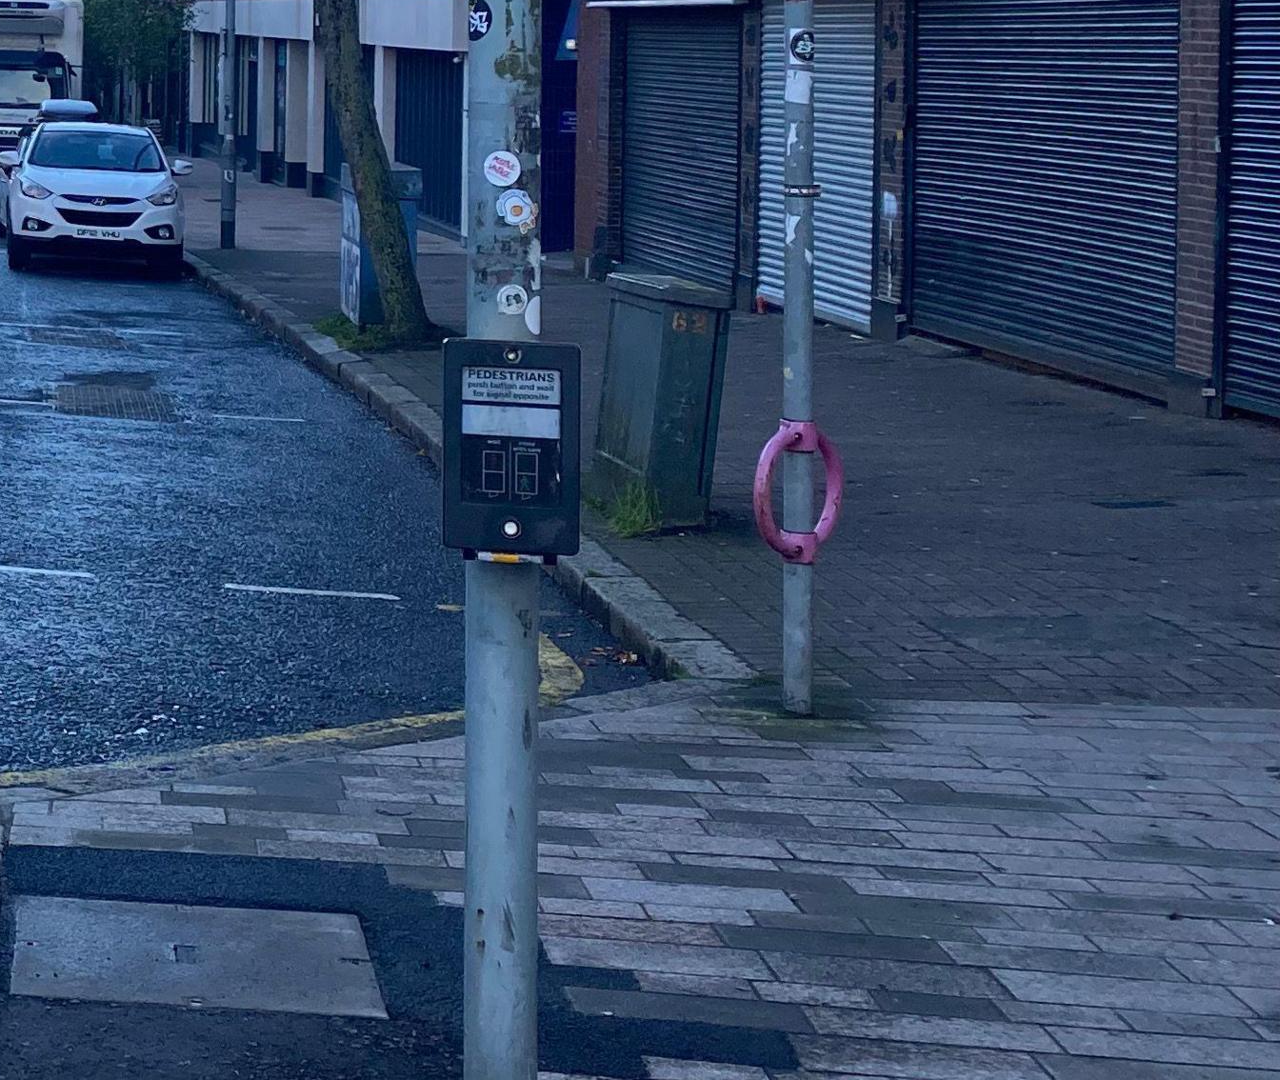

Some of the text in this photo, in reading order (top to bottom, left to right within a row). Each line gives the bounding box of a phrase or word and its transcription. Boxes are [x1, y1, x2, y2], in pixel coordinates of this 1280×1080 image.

[467, 368, 556, 383] PEDESTRIANS
[467, 381, 555, 392] push button and wait
[473, 389, 550, 401] for signal opposite
